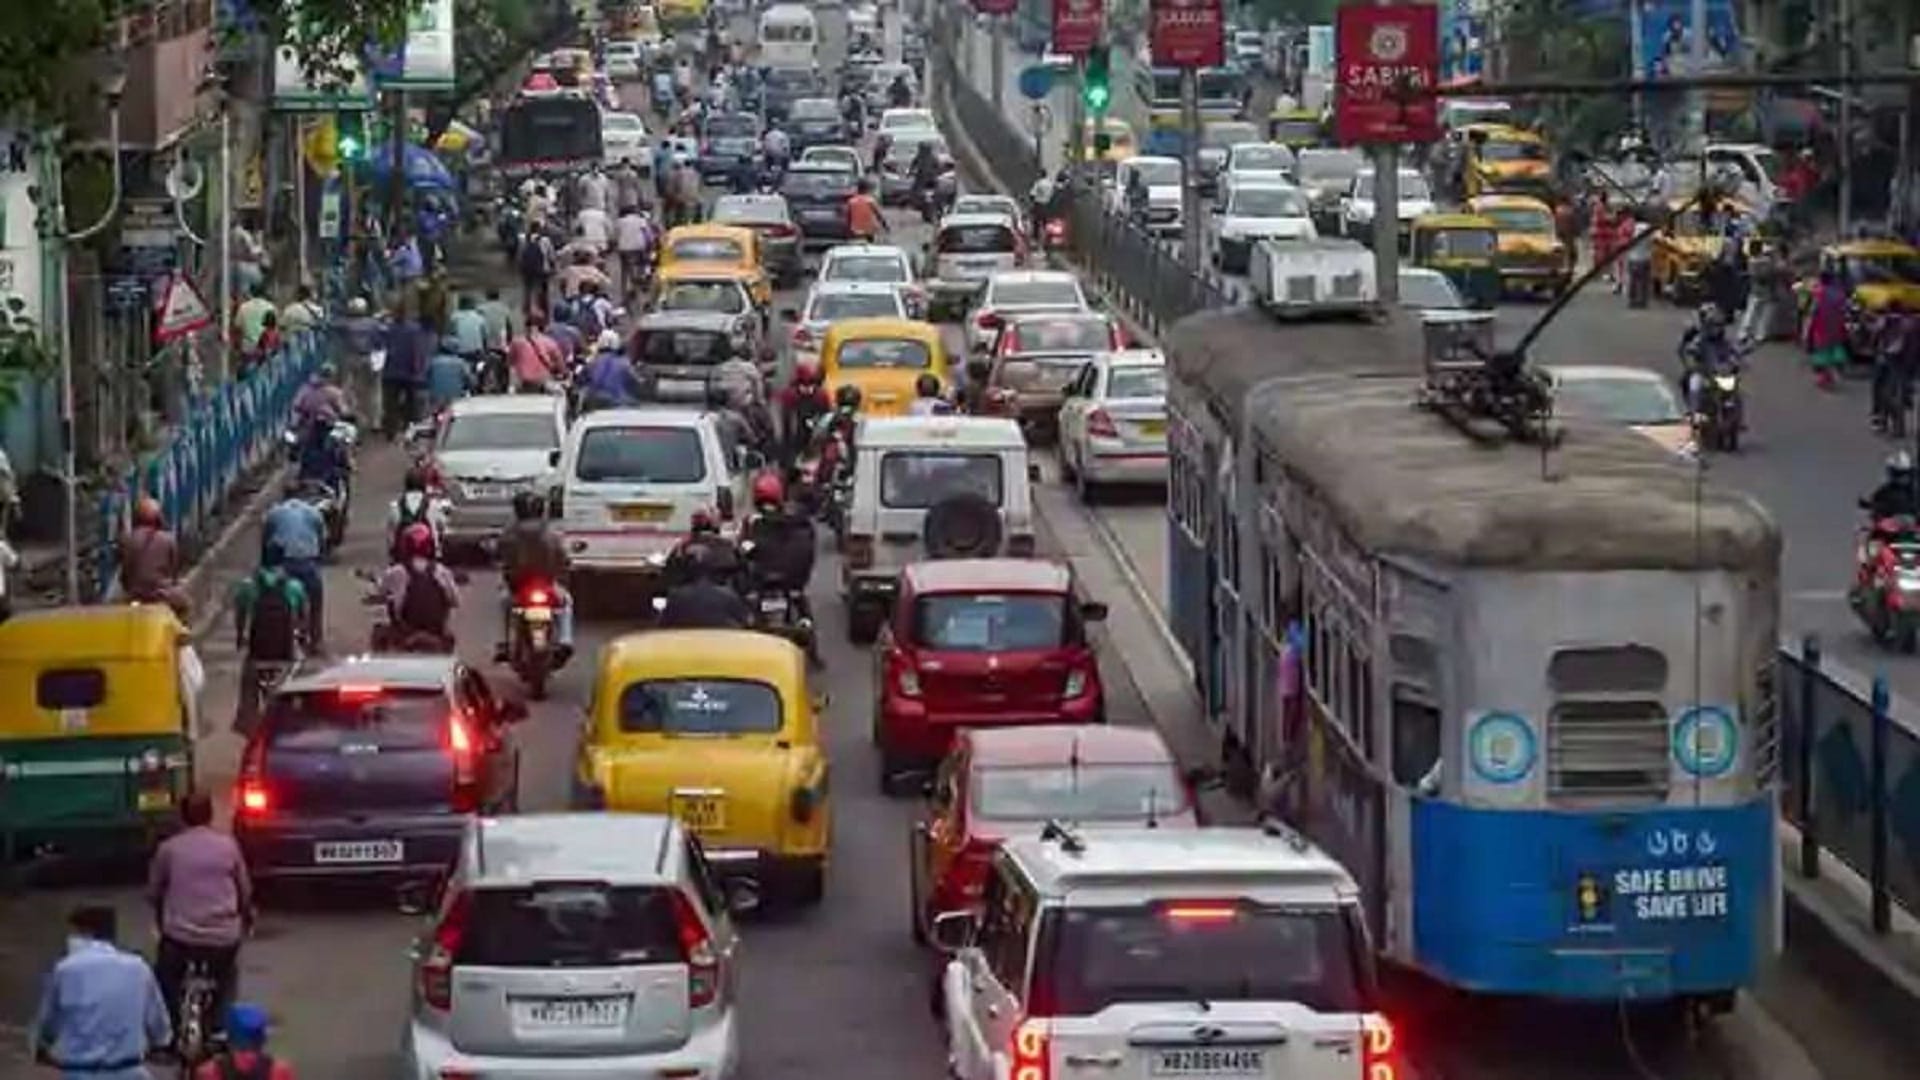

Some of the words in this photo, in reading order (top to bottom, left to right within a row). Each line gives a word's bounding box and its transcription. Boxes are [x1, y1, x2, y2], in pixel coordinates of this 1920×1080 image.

[1614, 868, 1664, 894] SAFE
[1668, 865, 1726, 892] DRIVE
[1635, 895, 1687, 919] SAVE
[1692, 892, 1727, 917] LIFE
